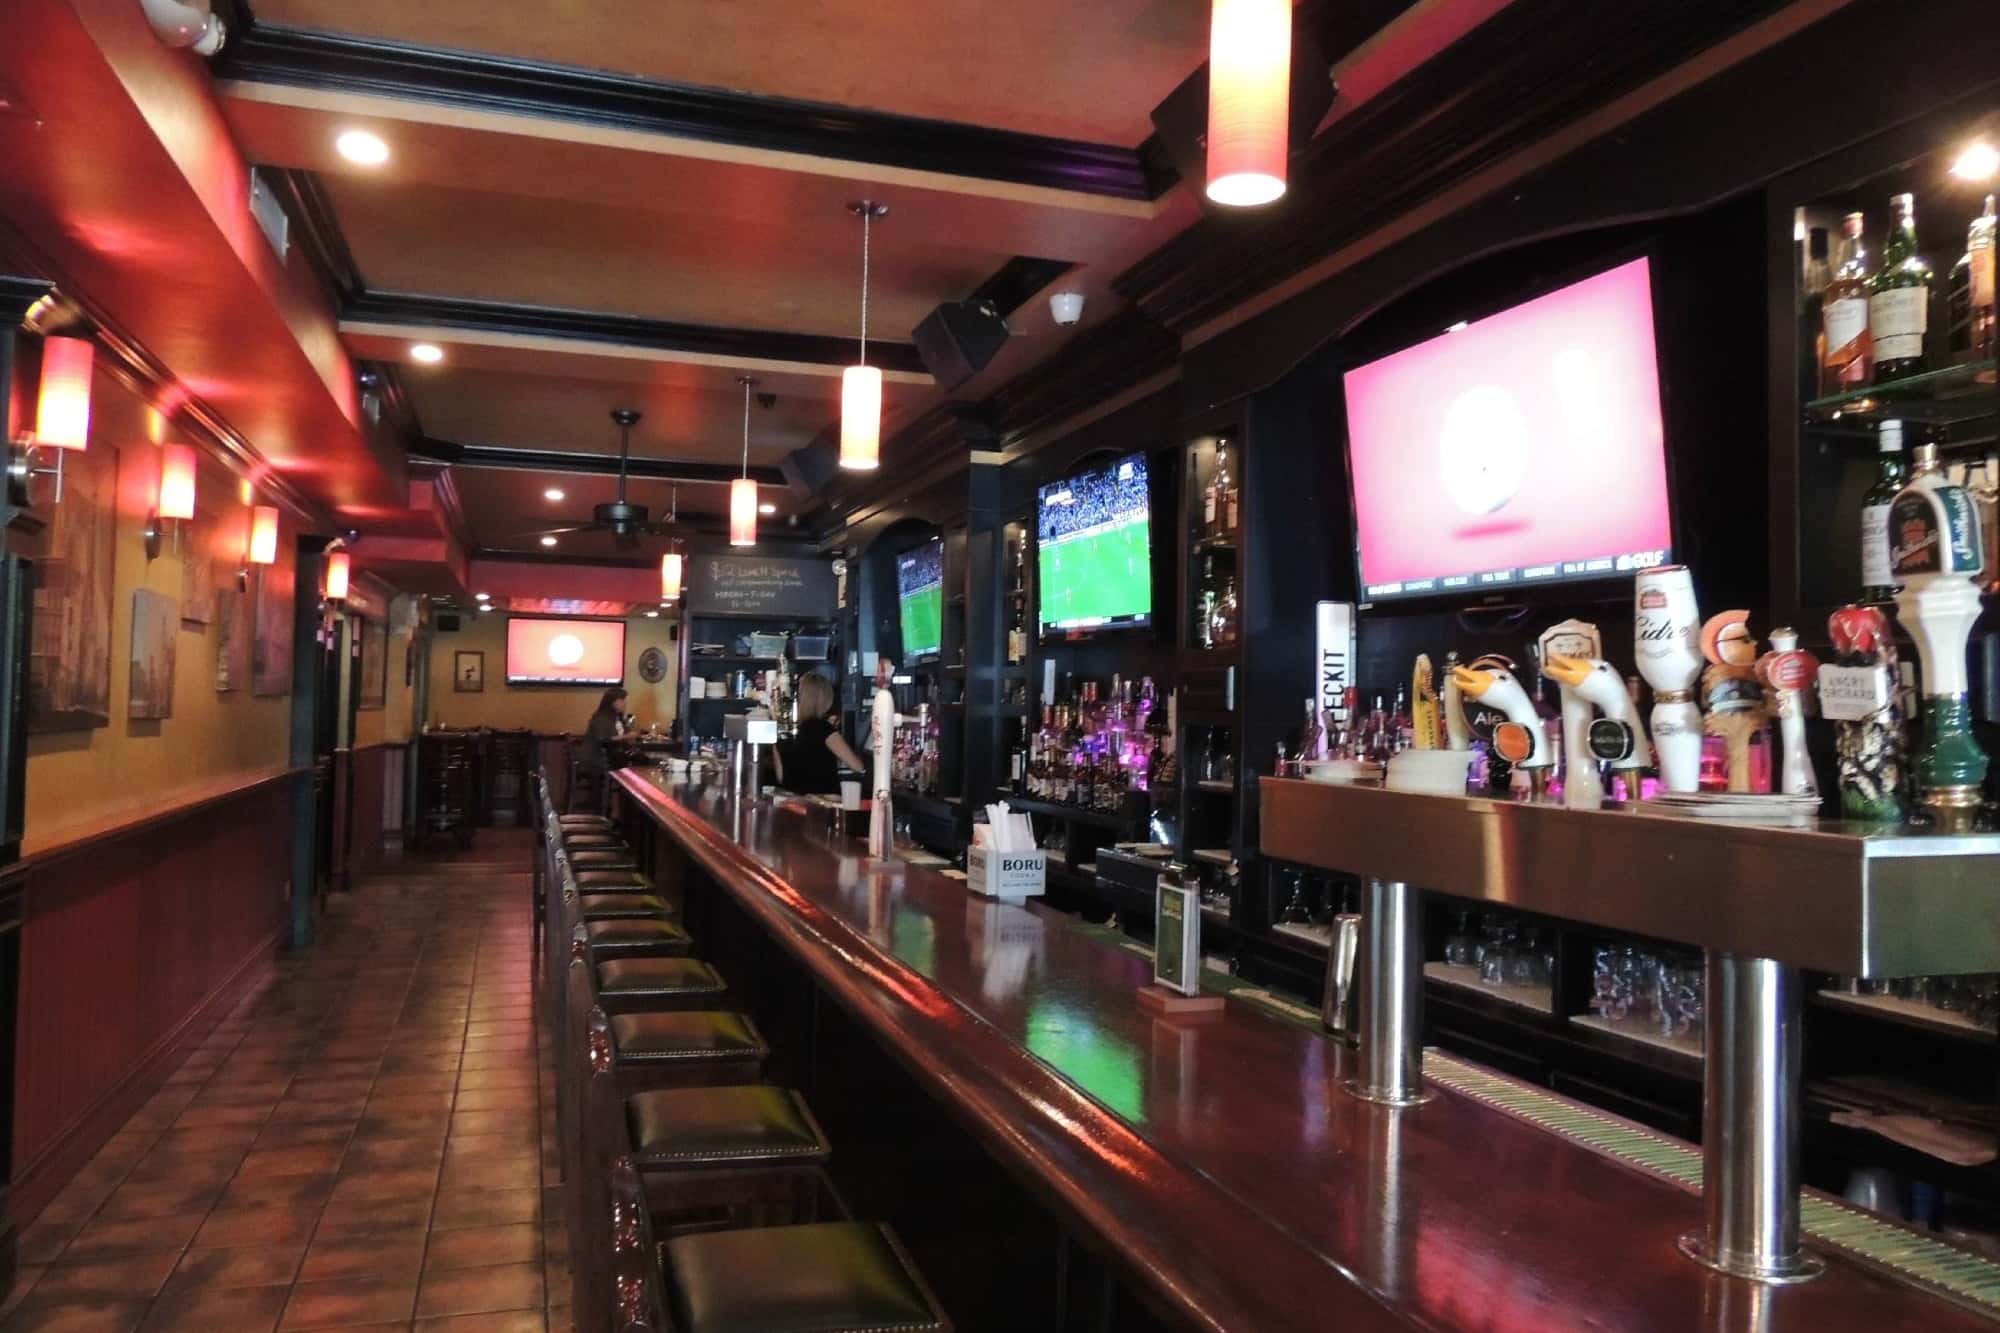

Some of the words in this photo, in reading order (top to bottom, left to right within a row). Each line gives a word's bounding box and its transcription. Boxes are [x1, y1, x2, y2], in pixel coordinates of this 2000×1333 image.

[1631, 550, 1664, 568] GOLF
[1636, 615, 1689, 641] Cidre
[1473, 711, 1503, 726] Ale
[1002, 859, 1043, 872] BORU
